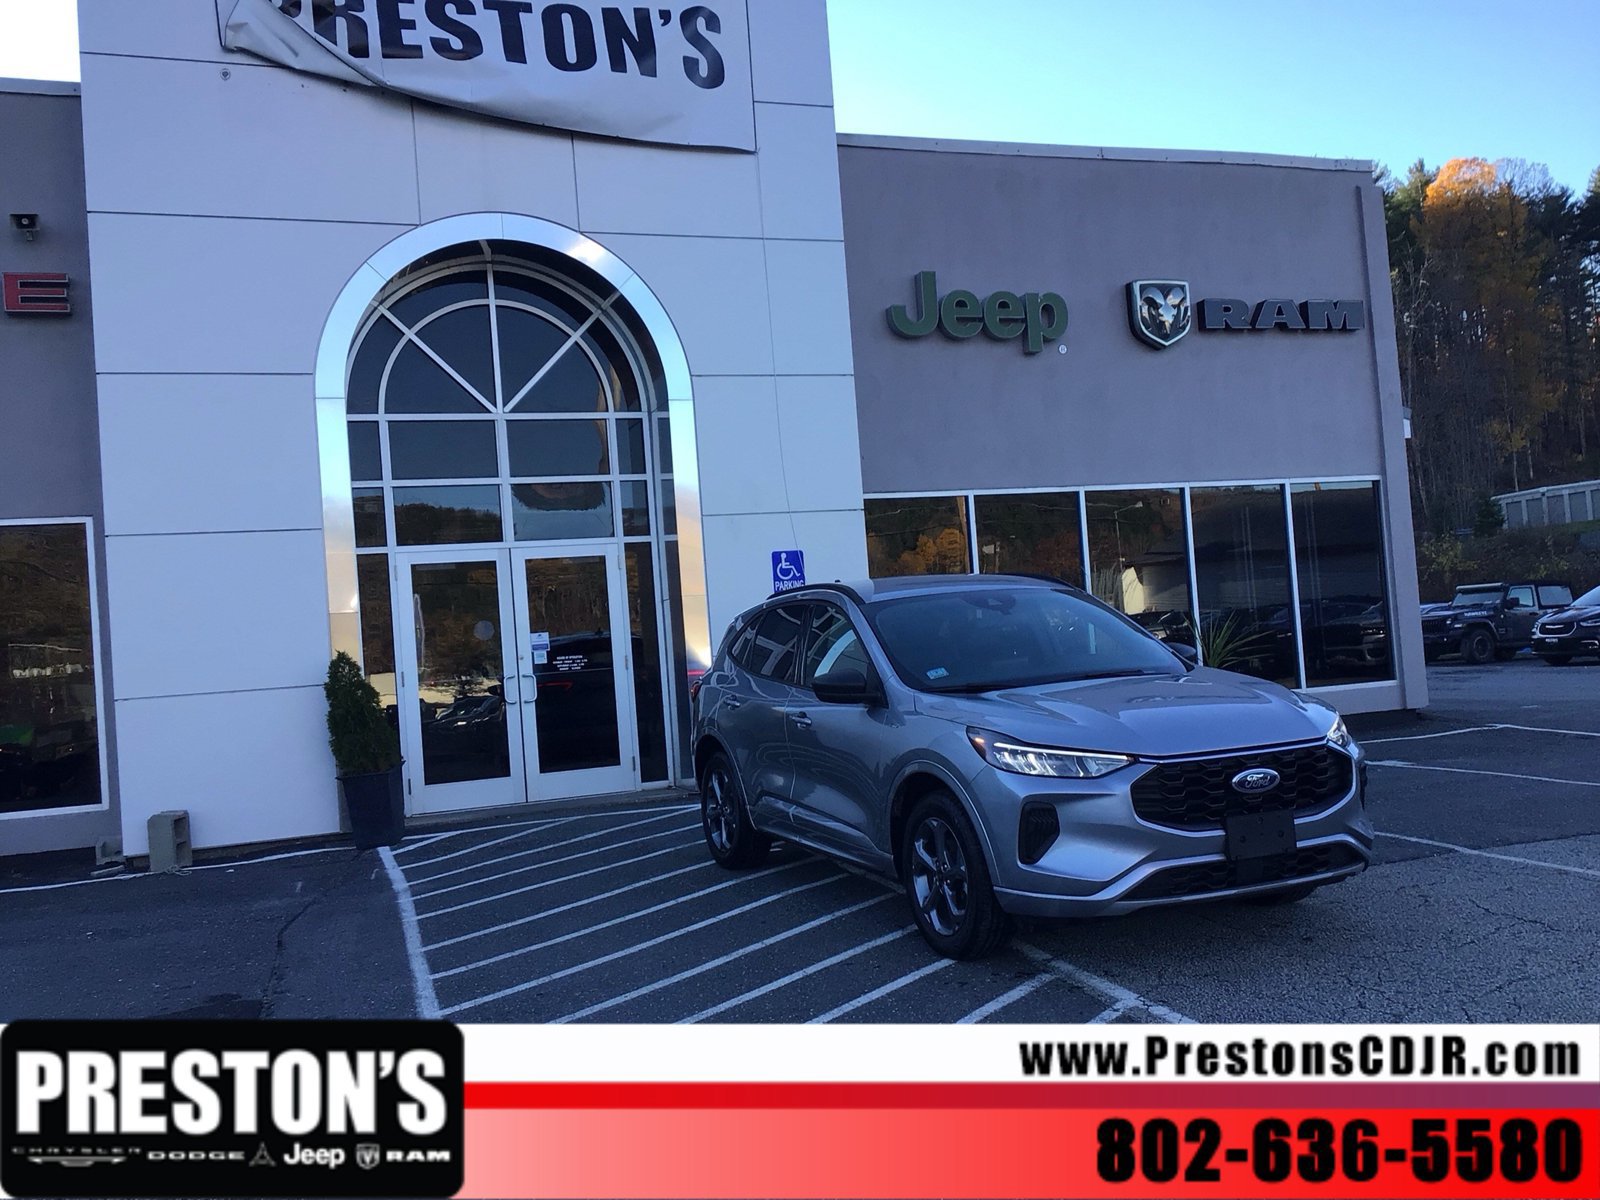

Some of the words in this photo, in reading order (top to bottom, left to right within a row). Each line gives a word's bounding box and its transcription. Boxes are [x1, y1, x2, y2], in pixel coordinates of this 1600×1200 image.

[268, 0, 725, 89] RESTON'S
[886, 270, 1068, 354] Jeep
[1198, 298, 1365, 331] RAM
[1245, 773, 1271, 788] Ford
